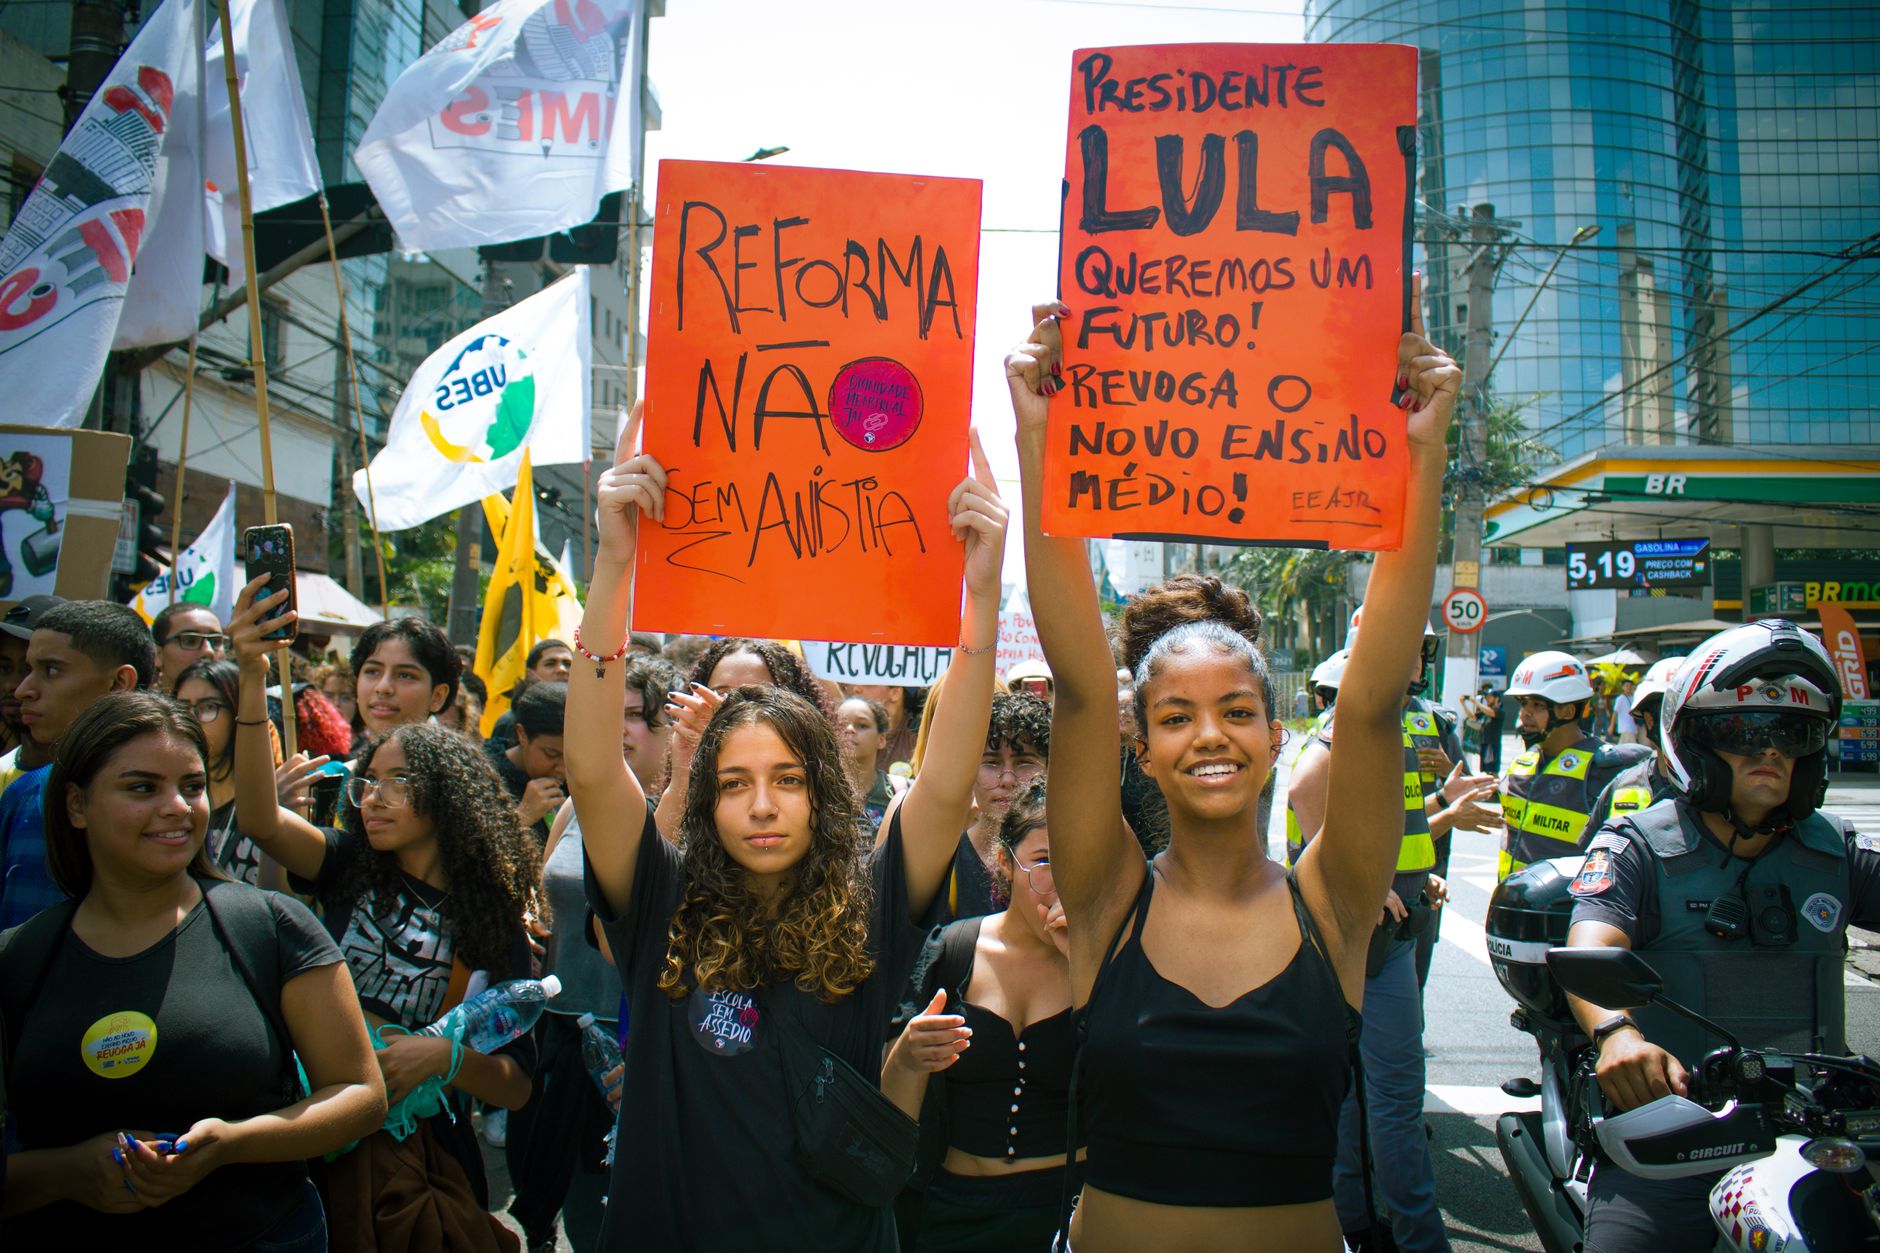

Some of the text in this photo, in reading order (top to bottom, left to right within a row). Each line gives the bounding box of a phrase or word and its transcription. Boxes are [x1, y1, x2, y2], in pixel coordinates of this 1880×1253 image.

[1076, 124, 1374, 237] LULA
[677, 200, 963, 340] REFORMA
[1075, 245, 1374, 299] QUEREMOS UM
[1077, 301, 1264, 352] FUTURO!
[1066, 363, 1312, 413] REVOGA O
[1068, 413, 1387, 465] NOVO ENSINO
[1068, 462, 1248, 524] MÉDIO!
[1645, 472, 1686, 495] BR
[661, 465, 927, 567] SEM ANISTIA
[1568, 543, 1680, 584] 5,19 GASOLINA
[1645, 560, 1693, 571] PREÇO COM
[1647, 570, 1692, 579] CASHBACK
[1451, 600, 1479, 619] 50
[1736, 685, 1809, 705] P M
[1532, 814, 1571, 833] MILITAR
[709, 989, 753, 1011] ESCOLA
[712, 1003, 734, 1020] SEM
[96, 1044, 134, 1060] REVOGA
[1689, 1142, 1745, 1159] CIRCUIT
